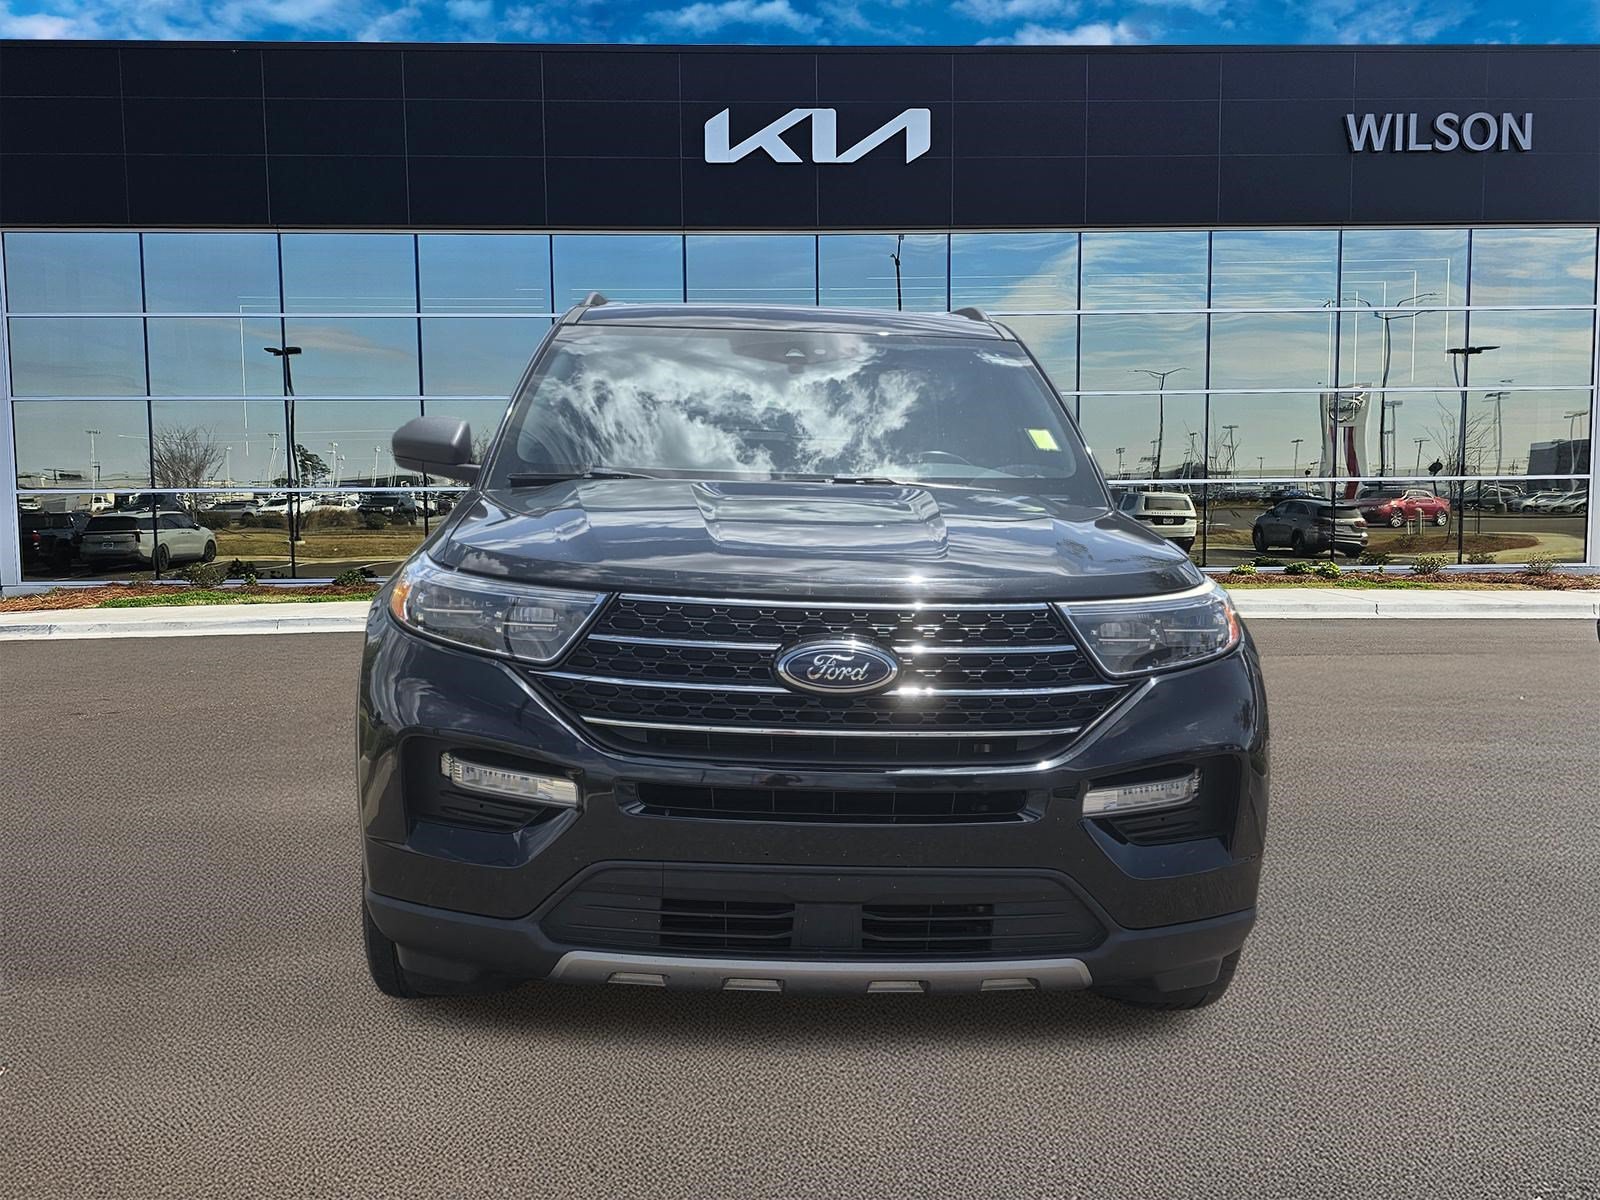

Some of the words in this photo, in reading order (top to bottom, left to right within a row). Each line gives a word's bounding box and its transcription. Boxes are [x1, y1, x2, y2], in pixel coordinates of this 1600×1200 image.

[704, 107, 931, 164] KIA
[1345, 111, 1534, 152] WILSON
[806, 653, 870, 682] Ford
